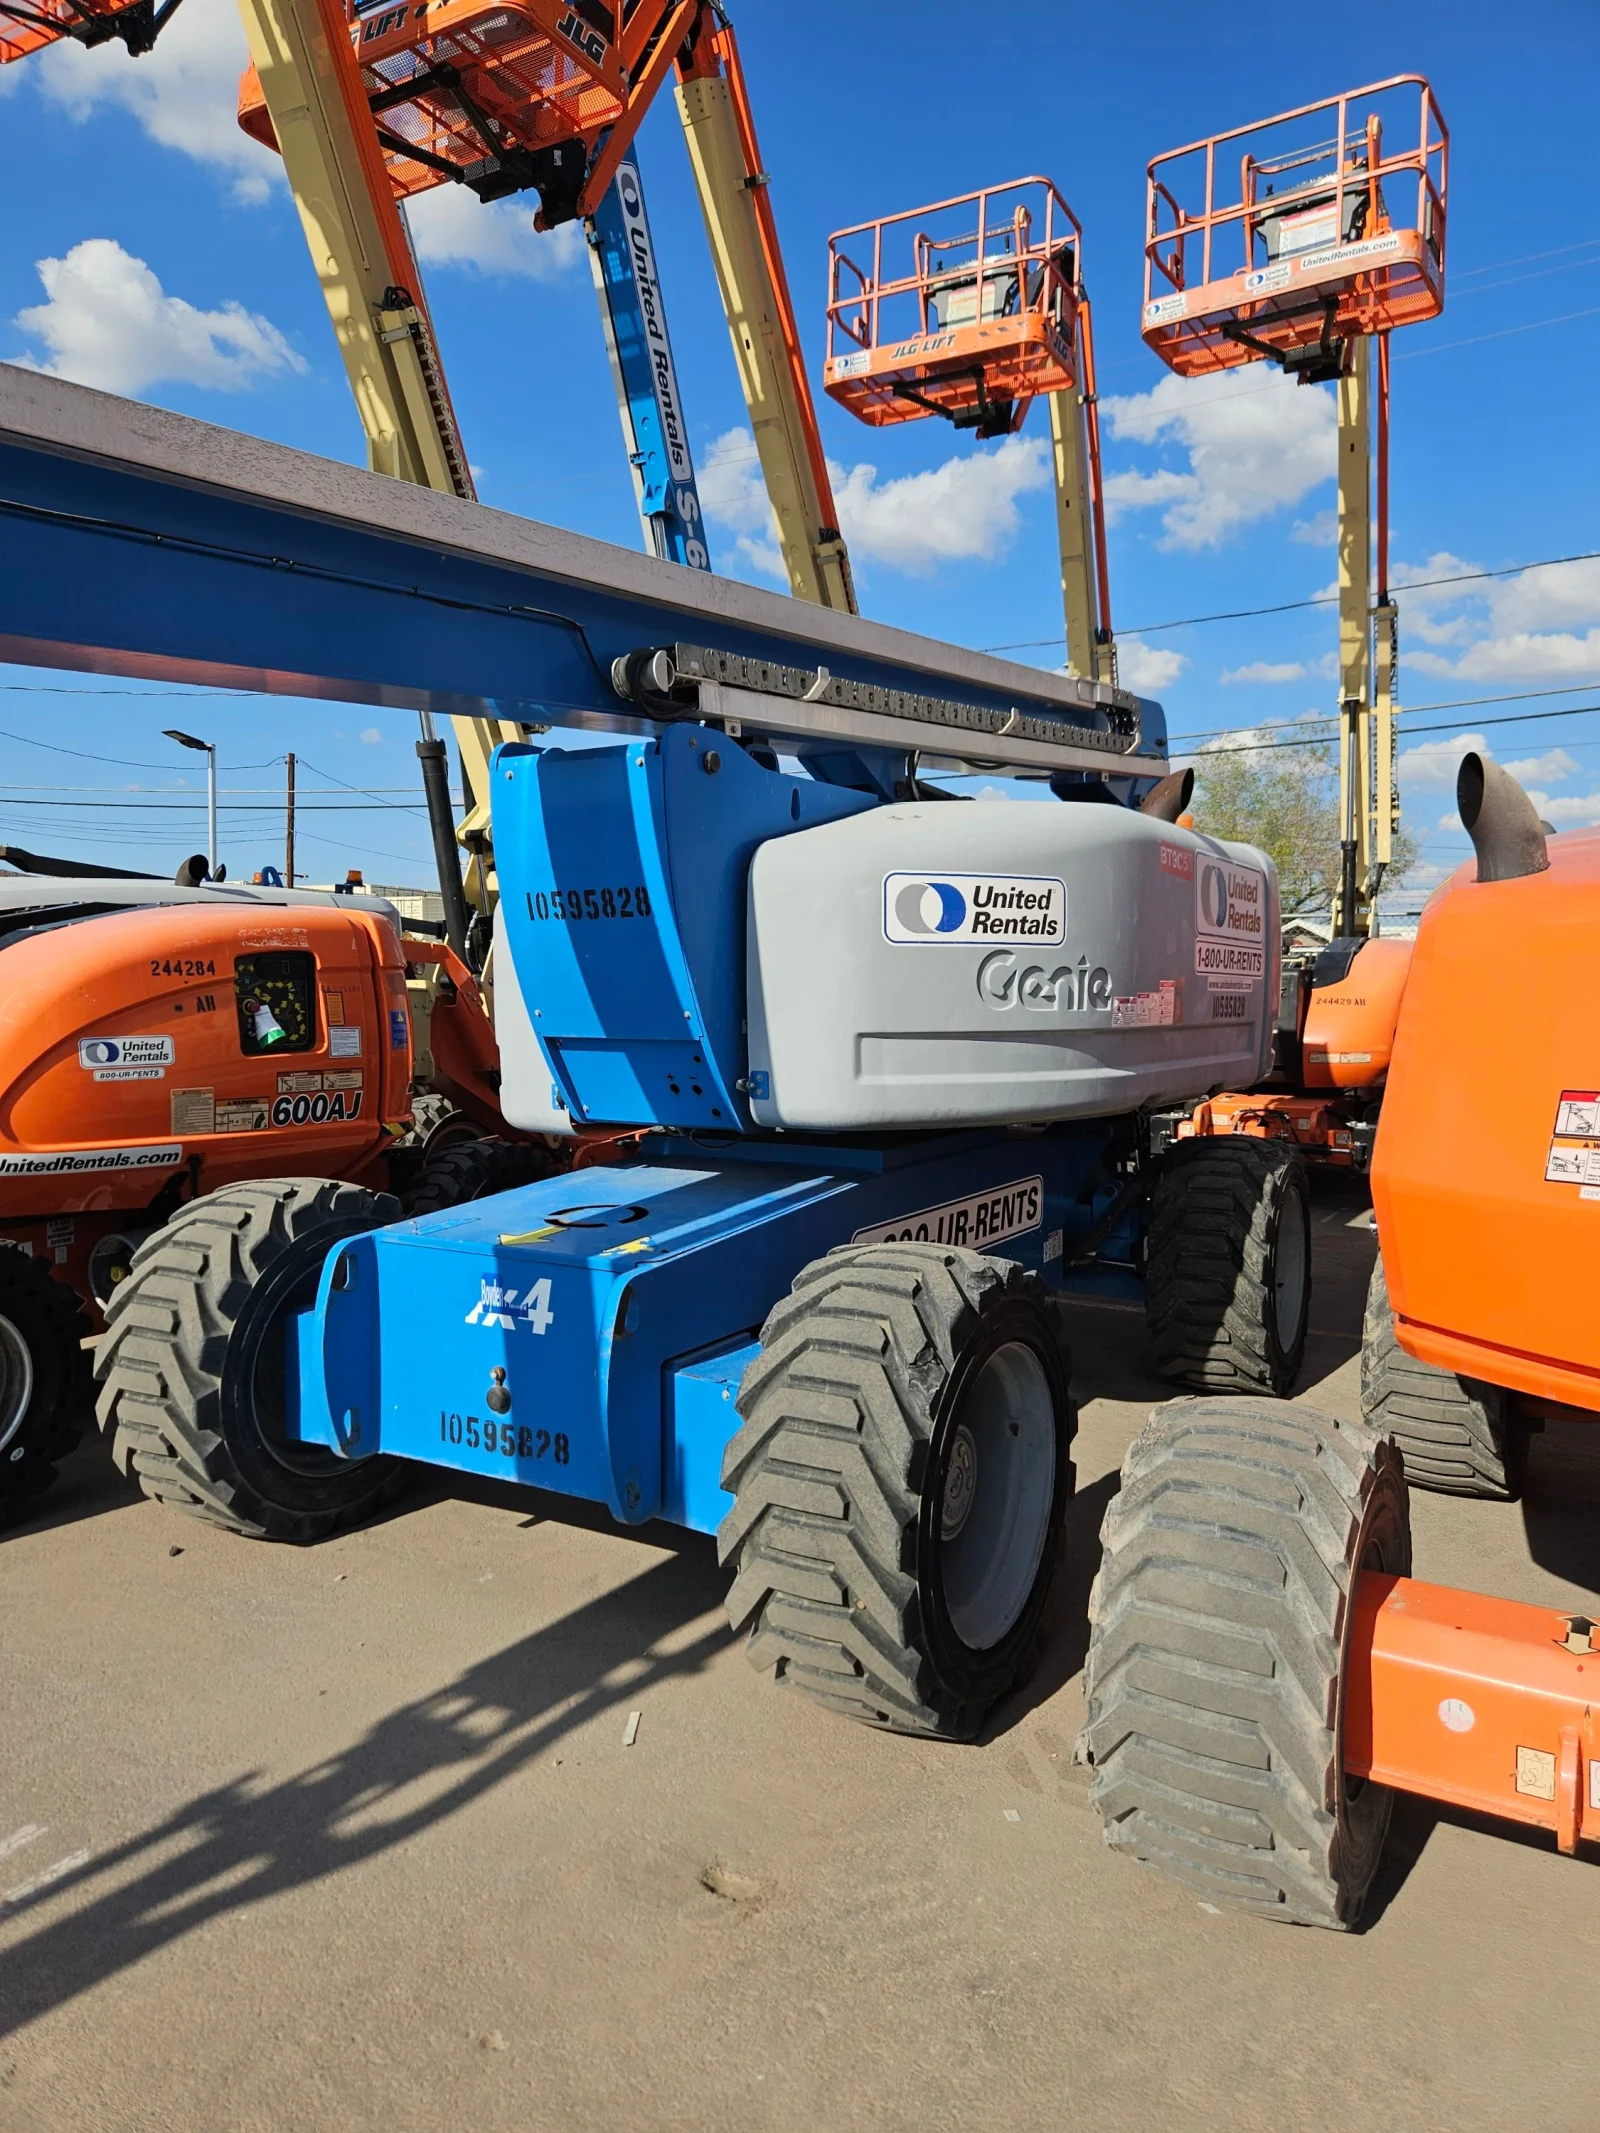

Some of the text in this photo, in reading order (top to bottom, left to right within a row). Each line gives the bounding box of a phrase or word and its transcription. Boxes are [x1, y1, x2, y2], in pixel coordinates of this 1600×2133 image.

[363, 4, 410, 44] LIFT
[556, 11, 607, 68] JLG
[1302, 240, 1398, 268] UnitedRentals.com
[630, 226, 684, 468] United Rentals
[890, 334, 957, 360] JLG LIFT
[972, 885, 1053, 911] United
[1227, 873, 1258, 904] United
[526, 886, 651, 921] 10595828
[971, 911, 1058, 936] Rentals
[1227, 903, 1261, 934] Rentals
[150, 960, 216, 976] 244284
[1197, 947, 1262, 972] 1-800-UR-RENTS
[976, 949, 1113, 1011] Genie
[1212, 995, 1246, 1019] 10595828
[122, 1040, 165, 1052] United
[122, 1053, 169, 1063] Rentals
[271, 1091, 363, 1127] 600AJ
[441, 1411, 570, 1466] 10595828
